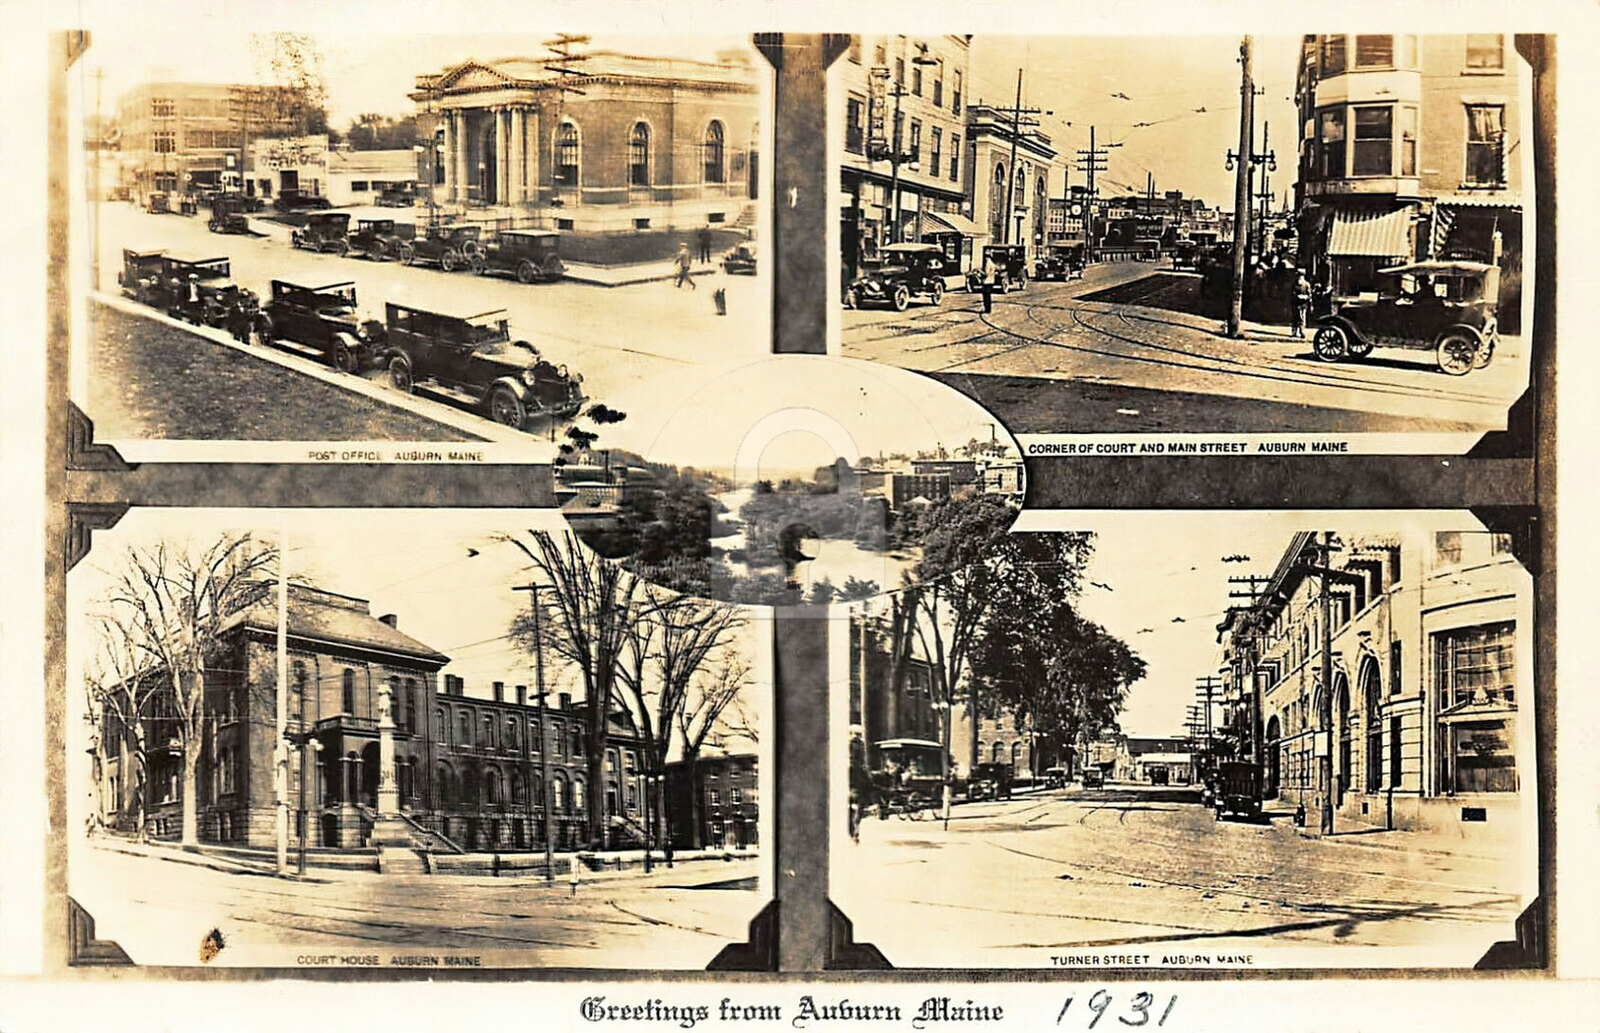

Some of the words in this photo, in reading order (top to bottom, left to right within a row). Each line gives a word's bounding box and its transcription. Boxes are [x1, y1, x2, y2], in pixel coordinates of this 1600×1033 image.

[1028, 443, 1077, 455] CORNER
[1079, 443, 1094, 455] OF
[1096, 443, 1136, 455] COURT
[1139, 443, 1165, 455] AND
[1167, 443, 1198, 455] MAIN
[1200, 443, 1247, 455] STREET
[1258, 443, 1306, 455] AUBURN
[1311, 443, 1348, 455] MAINE
[308, 451, 336, 462] POST
[341, 451, 382, 462] OFFICE
[394, 451, 442, 462] AUBURN
[448, 451, 484, 462] MAINE
[297, 955, 336, 967] COURT
[341, 955, 379, 967] HOUSE
[391, 955, 439, 967] AUBURN
[443, 955, 481, 967] MAINE
[1051, 955, 1100, 966] TURNER
[1103, 955, 1150, 966] STREET
[1162, 955, 1211, 966] AUBURN
[1216, 955, 1254, 966] MAINE
[580, 996, 710, 1028] Greetings
[718, 998, 782, 1021] from
[791, 996, 903, 1029] Auburn
[912, 996, 1004, 1030] Maine
[1057, 989, 1179, 1029] 1931
